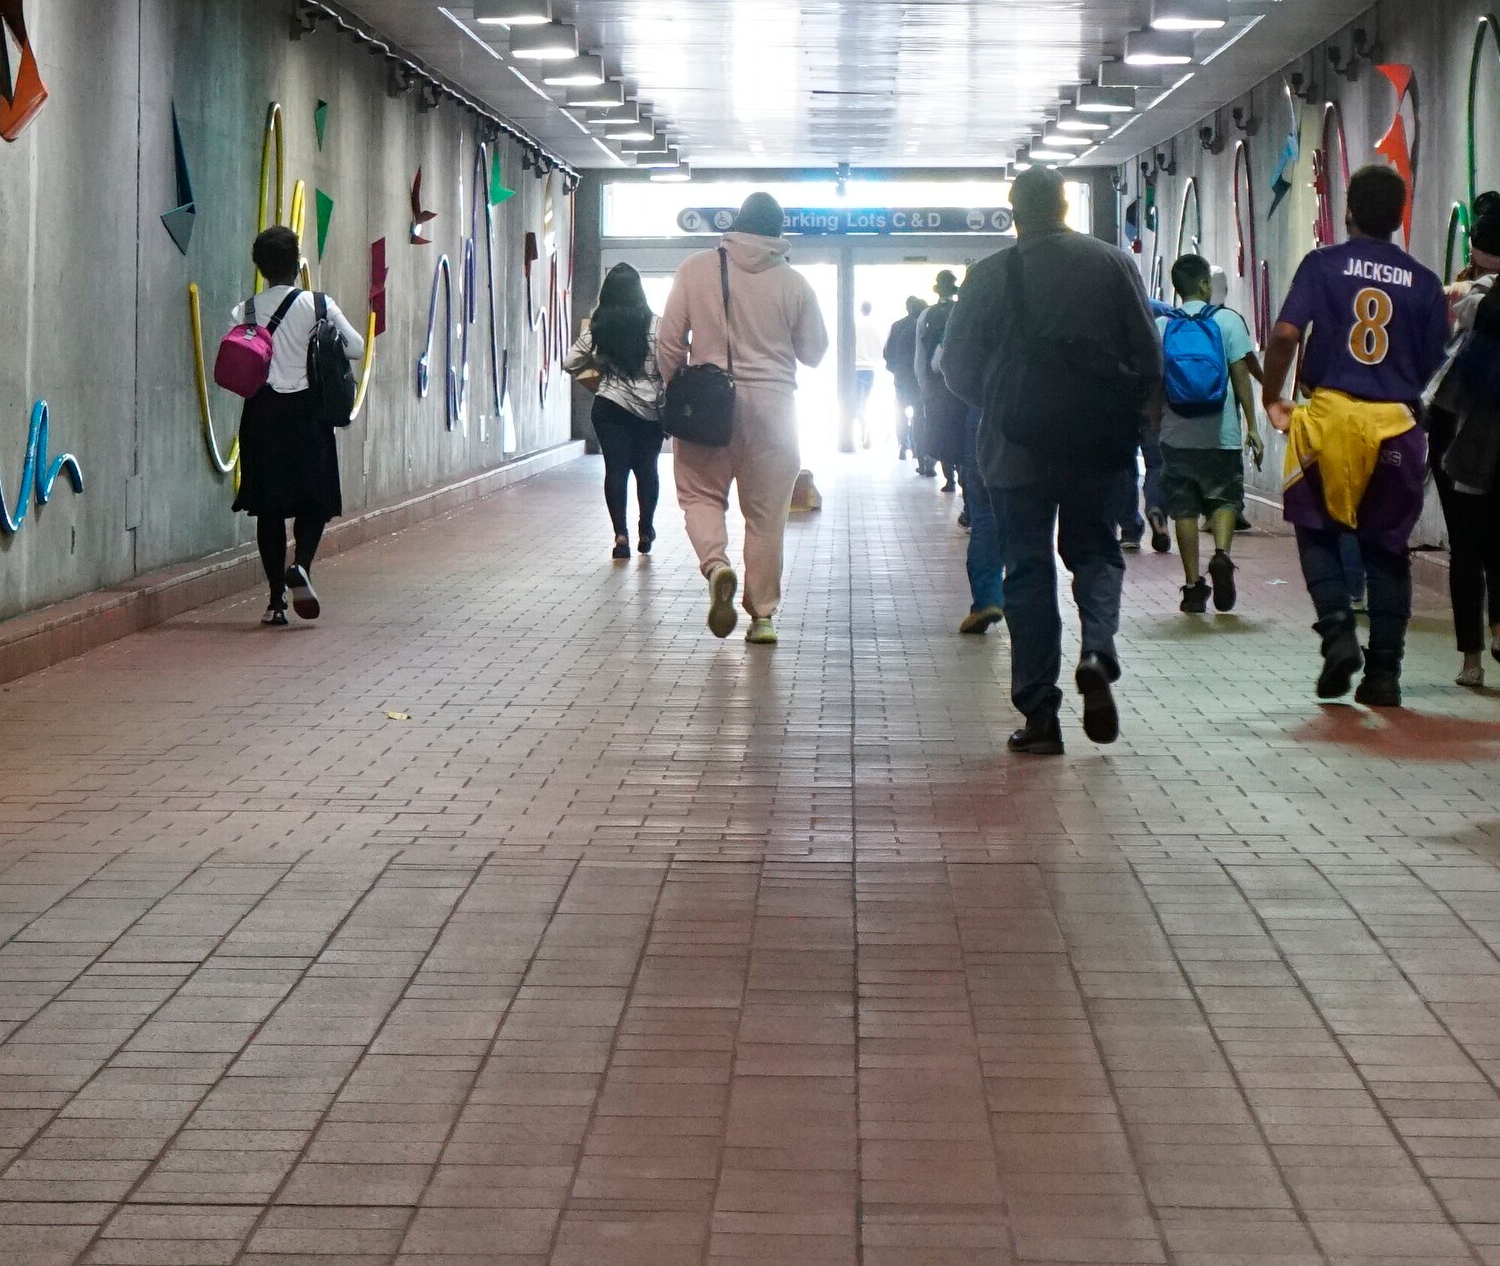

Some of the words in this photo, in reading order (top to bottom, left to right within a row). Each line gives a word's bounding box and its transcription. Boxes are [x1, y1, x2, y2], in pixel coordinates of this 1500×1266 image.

[782, 212, 838, 231] arking
[847, 212, 886, 228] Lots
[892, 212, 907, 228] C
[911, 212, 924, 228] &
[928, 212, 941, 228] D
[1343, 257, 1413, 288] JACKSON
[1347, 286, 1394, 366] 8
